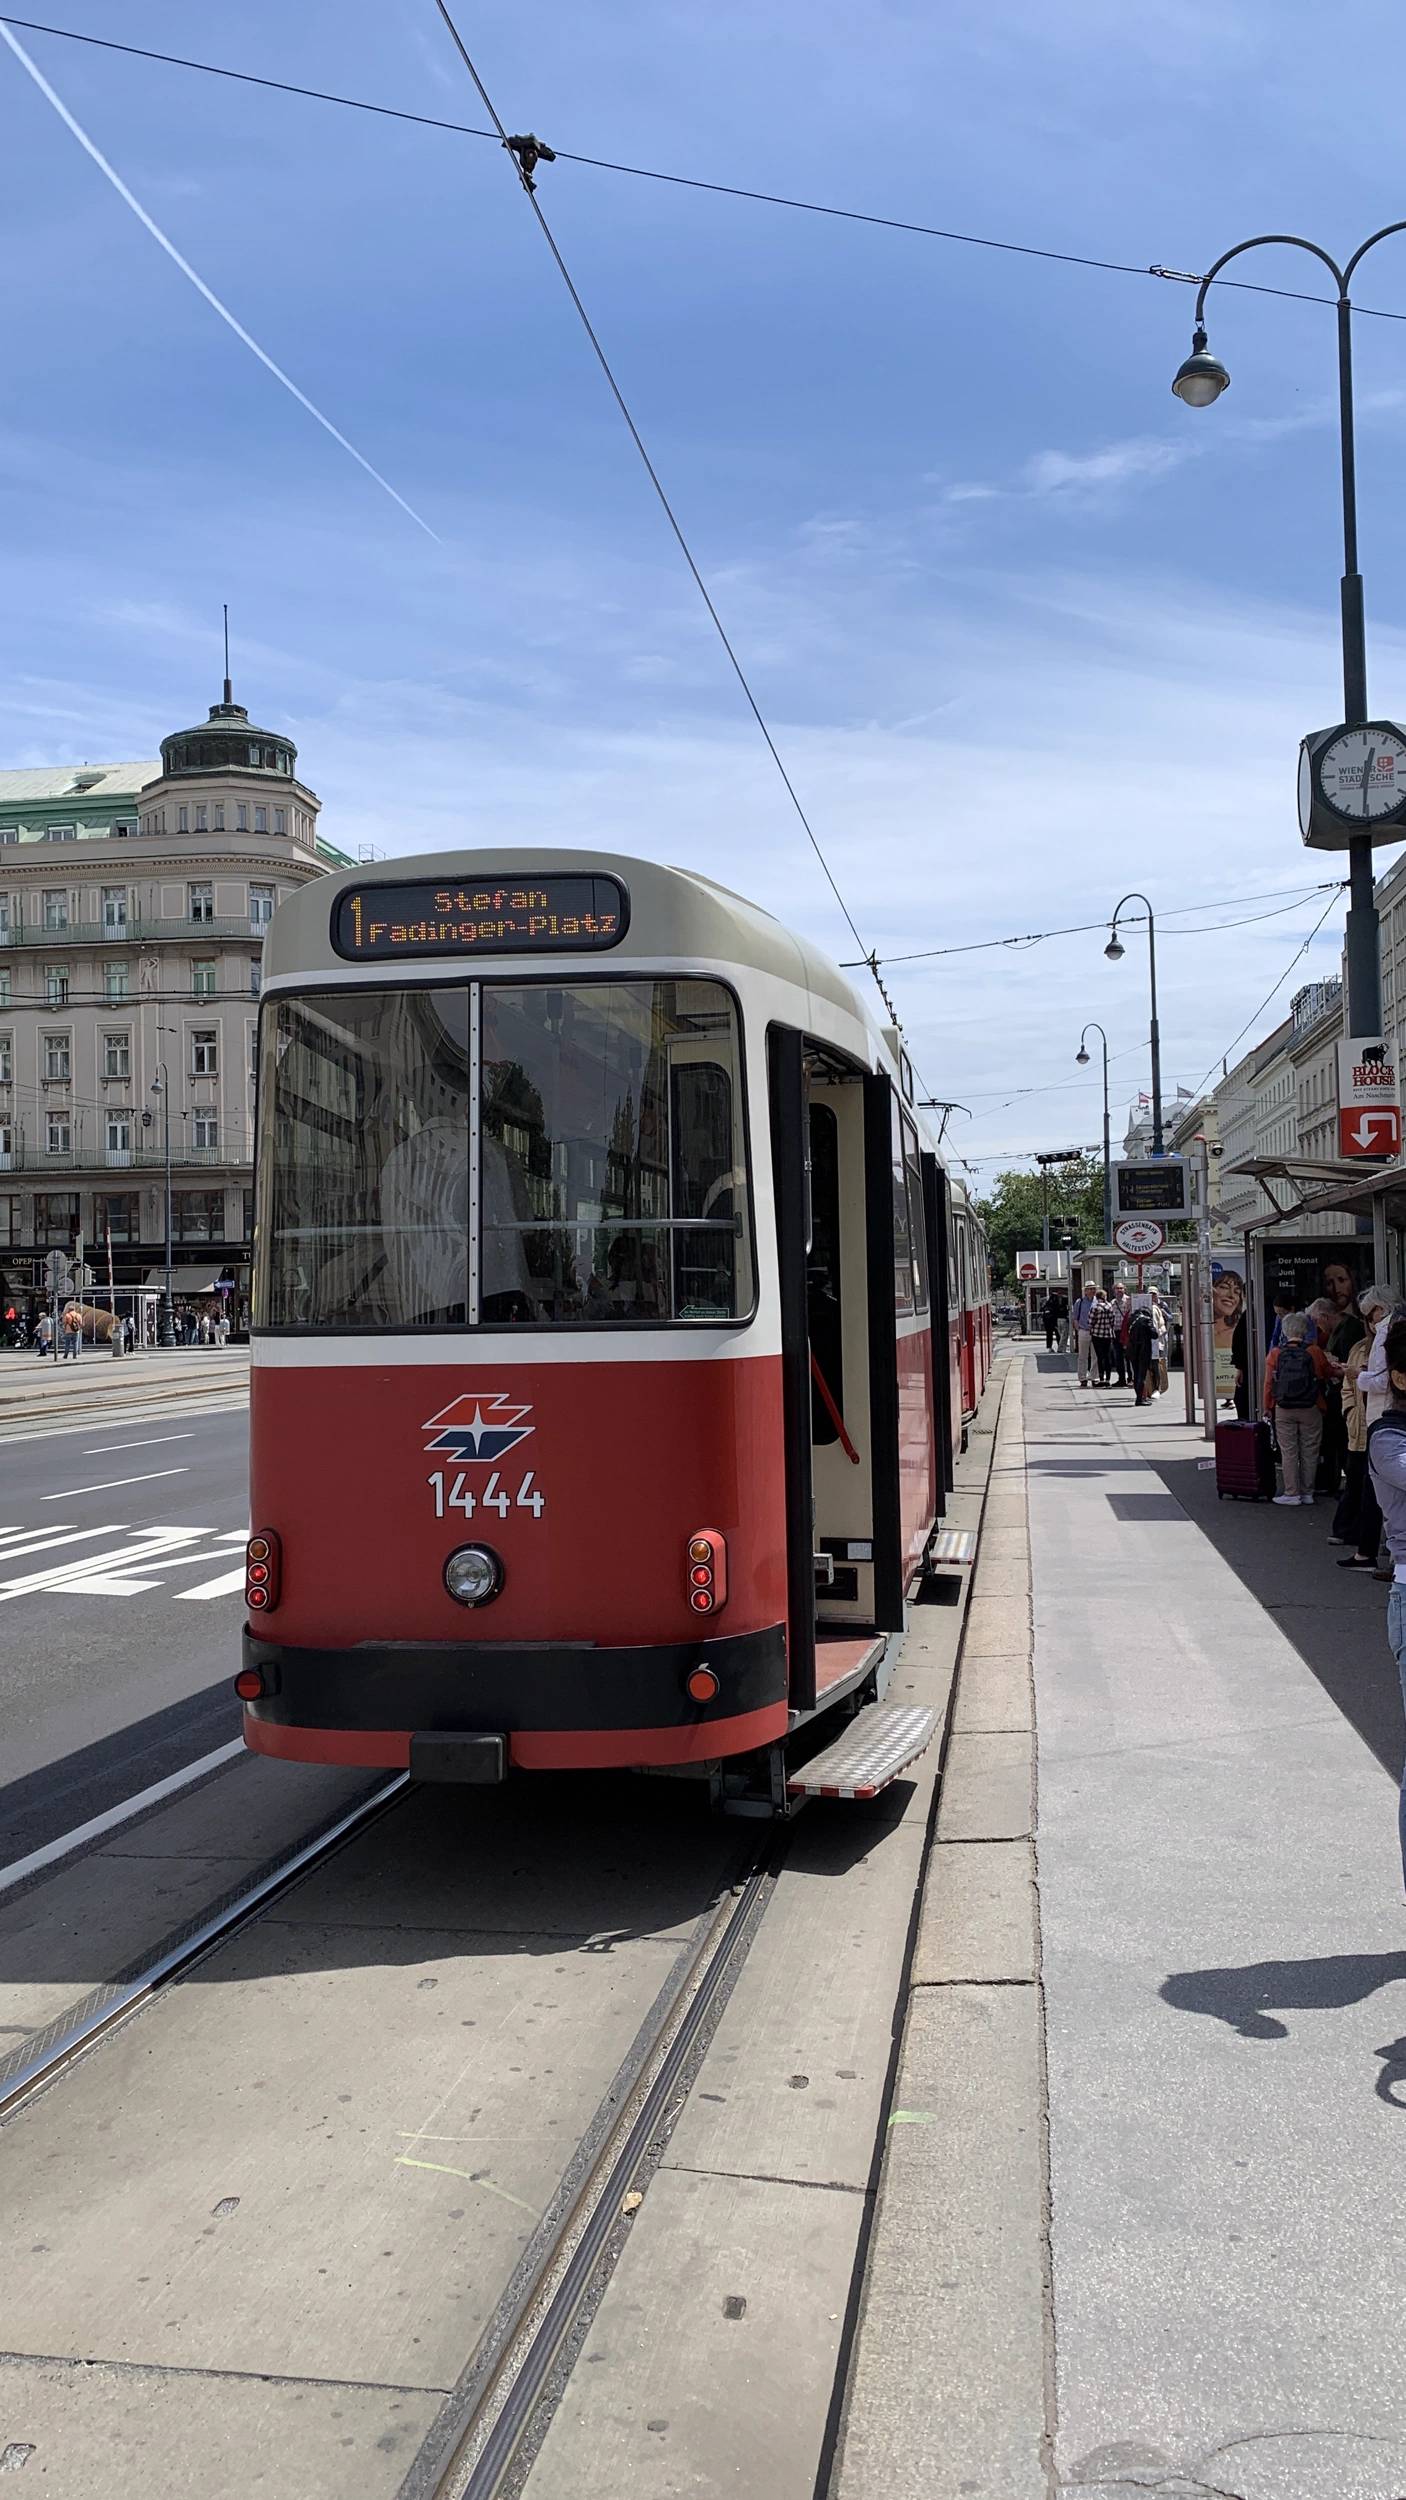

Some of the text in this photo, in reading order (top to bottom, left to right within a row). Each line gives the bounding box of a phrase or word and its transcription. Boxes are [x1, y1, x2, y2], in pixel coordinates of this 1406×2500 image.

[1338, 766, 1376, 774] WIENR
[1338, 773, 1394, 784] STÄDSCHE
[434, 889, 548, 912] Stefan
[350, 896, 362, 947] 1
[368, 914, 617, 944] Fadinger-Platz
[1352, 1066, 1394, 1076] BLOCK
[1352, 1076, 1396, 1086] HOUSE
[1120, 1222, 1158, 1235] STRASSENBAHN
[1122, 1241, 1156, 1252] HALTESTELLE
[427, 1471, 545, 1519] 1444
